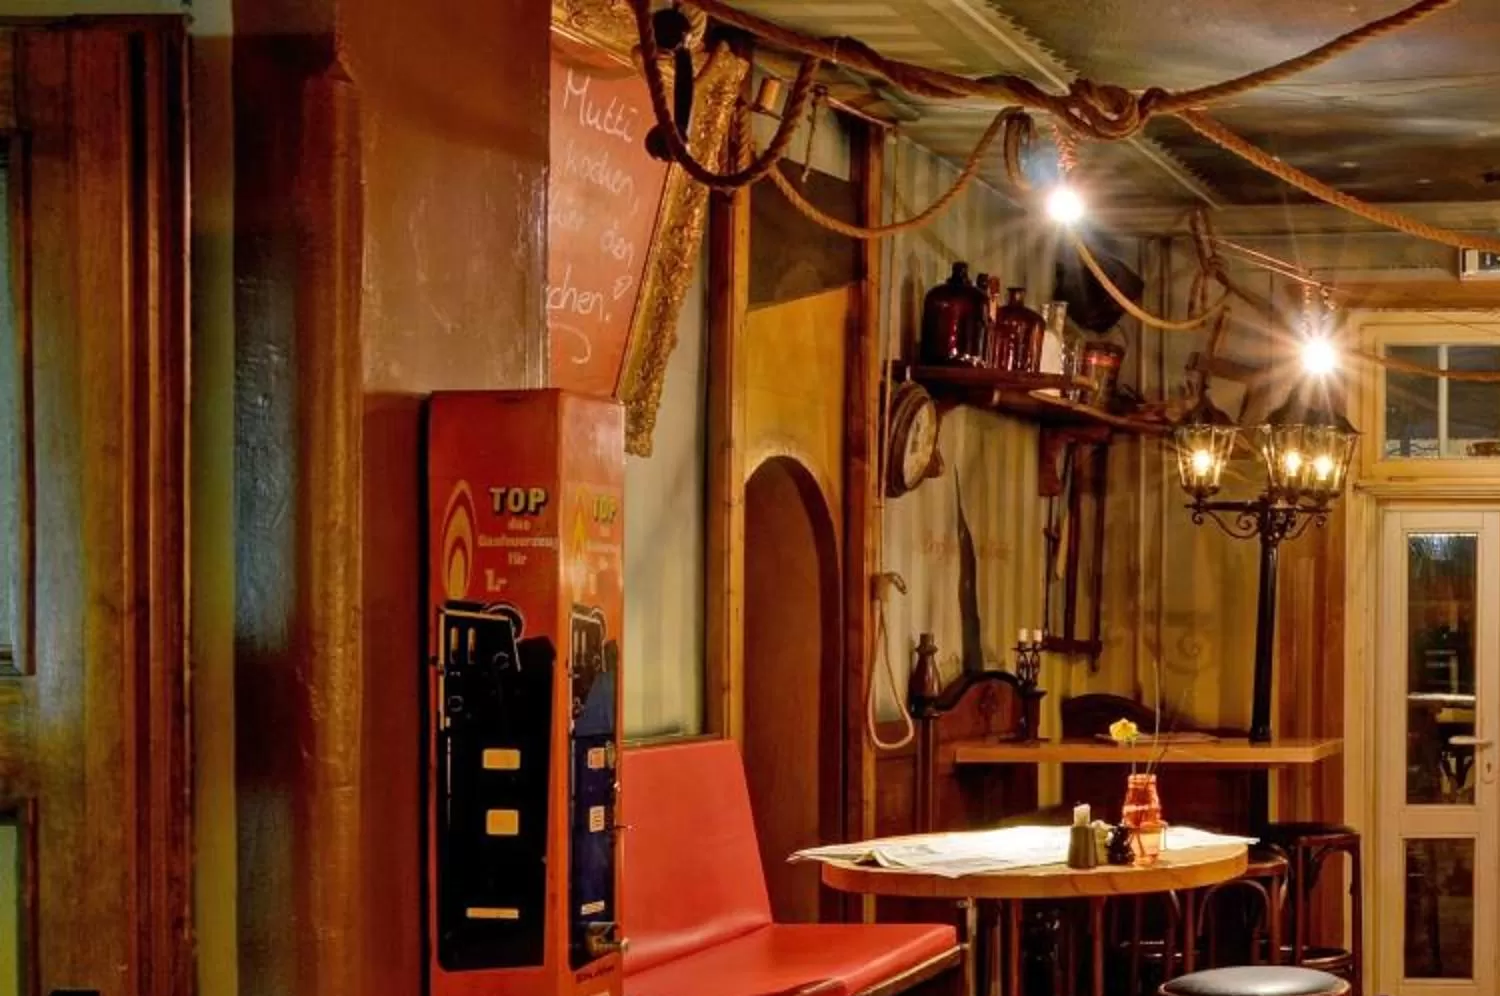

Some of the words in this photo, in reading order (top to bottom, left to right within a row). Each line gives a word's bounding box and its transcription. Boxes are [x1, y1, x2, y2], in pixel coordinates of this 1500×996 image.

[563, 67, 638, 142] Mutti
[547, 263, 610, 321] chen.
[489, 486, 548, 515] TOP
